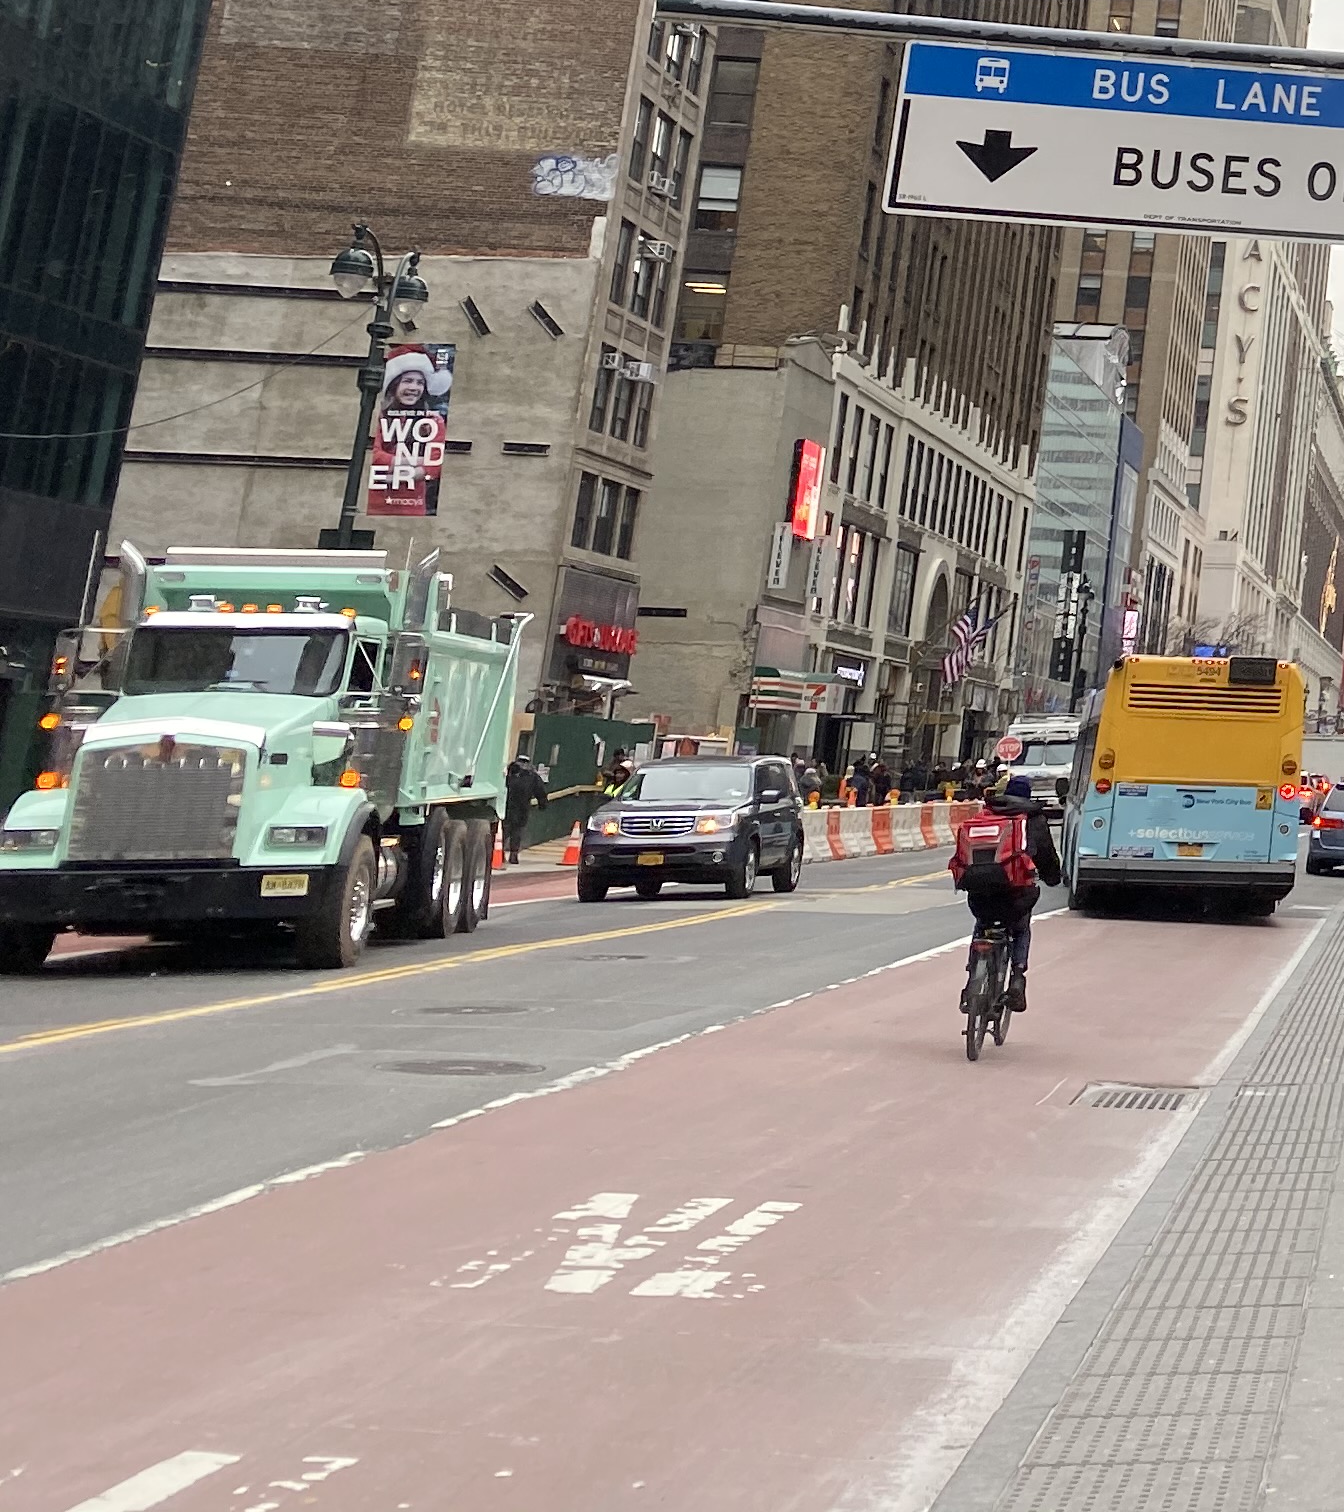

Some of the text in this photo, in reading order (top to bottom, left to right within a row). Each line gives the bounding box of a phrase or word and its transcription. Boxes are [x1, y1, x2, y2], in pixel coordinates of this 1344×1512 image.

[1092, 69, 1322, 118] BUS LANE
[1113, 147, 1282, 198] BUSES
[1177, 216, 1243, 226] TRANSPORTATION
[1225, 240, 1263, 426] ACY'S
[380, 418, 438, 443] WO
[394, 442, 445, 467] ND
[367, 465, 416, 490] ER
[1000, 742, 1020, 753] STOP
